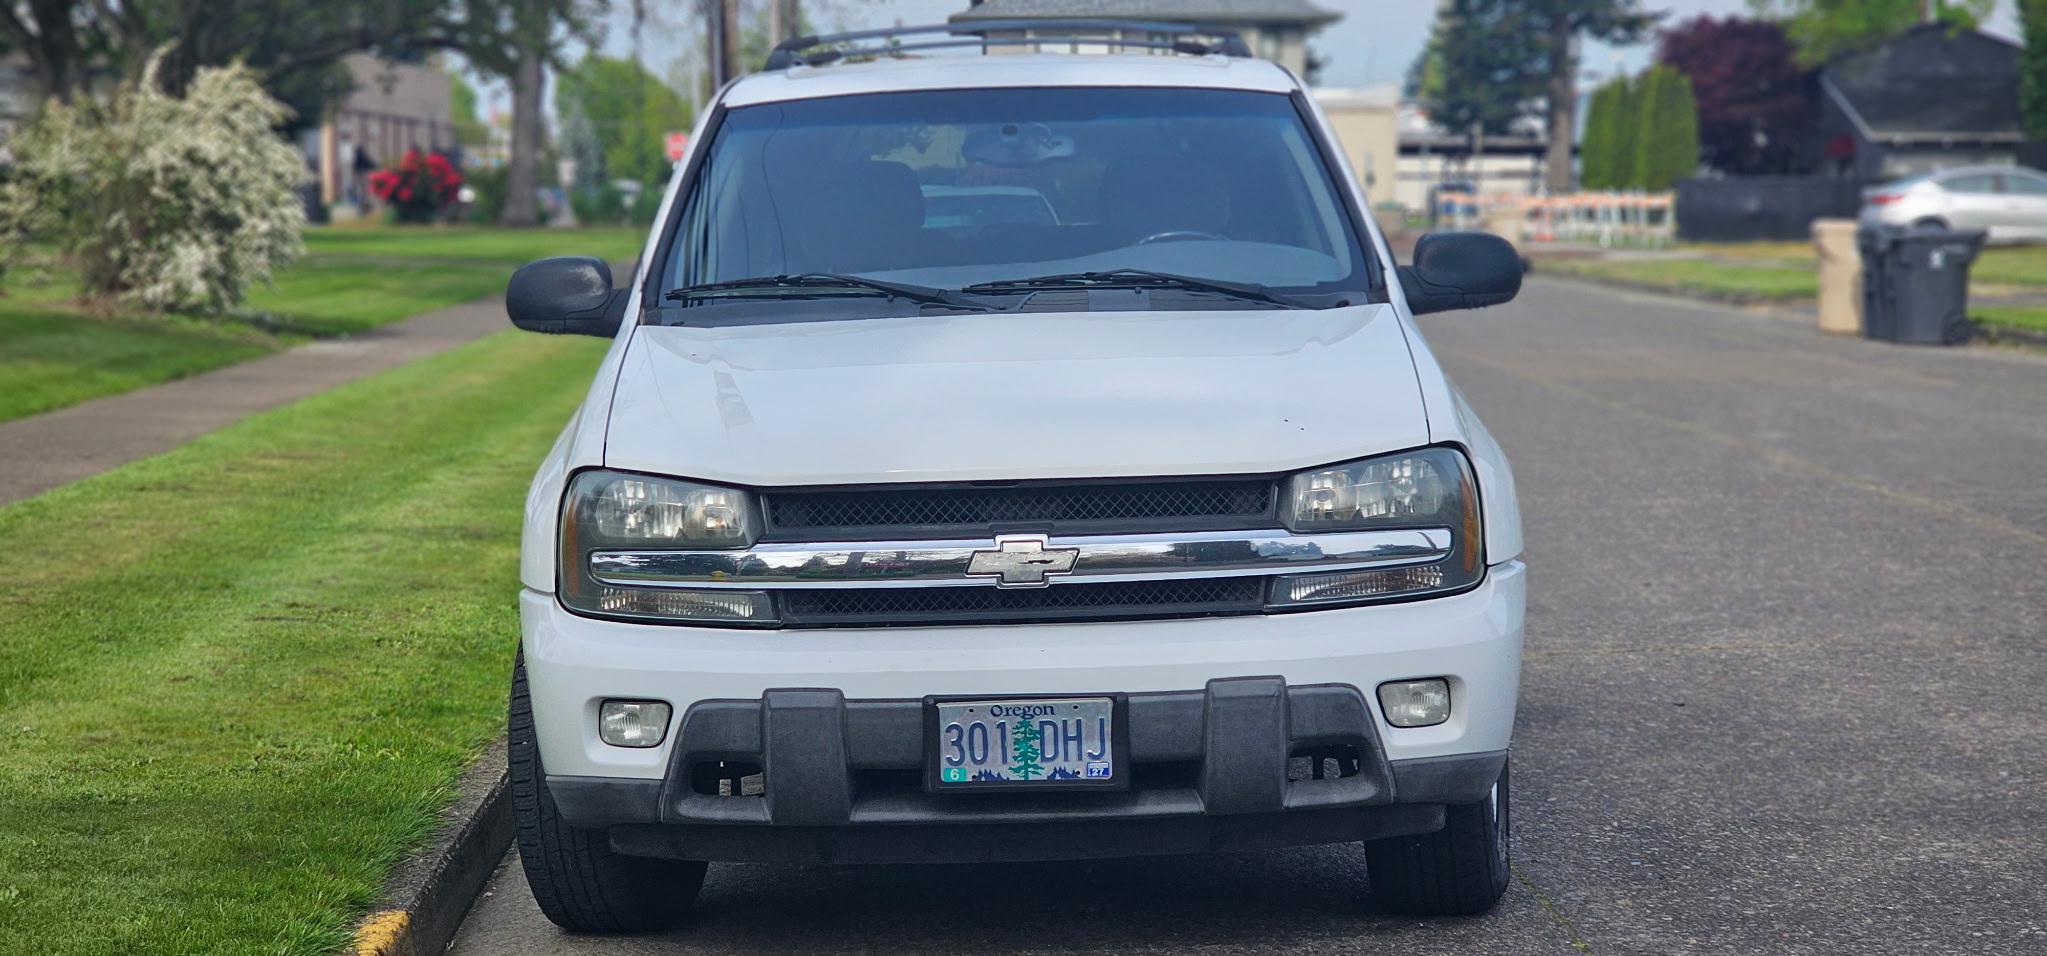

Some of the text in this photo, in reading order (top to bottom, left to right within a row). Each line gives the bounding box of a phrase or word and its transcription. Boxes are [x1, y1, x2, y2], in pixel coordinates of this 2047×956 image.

[990, 704, 1056, 720] Oregon
[945, 718, 1106, 766] 301 DHJ
[950, 768, 960, 780] 6
[1091, 768, 1105, 776] 27
